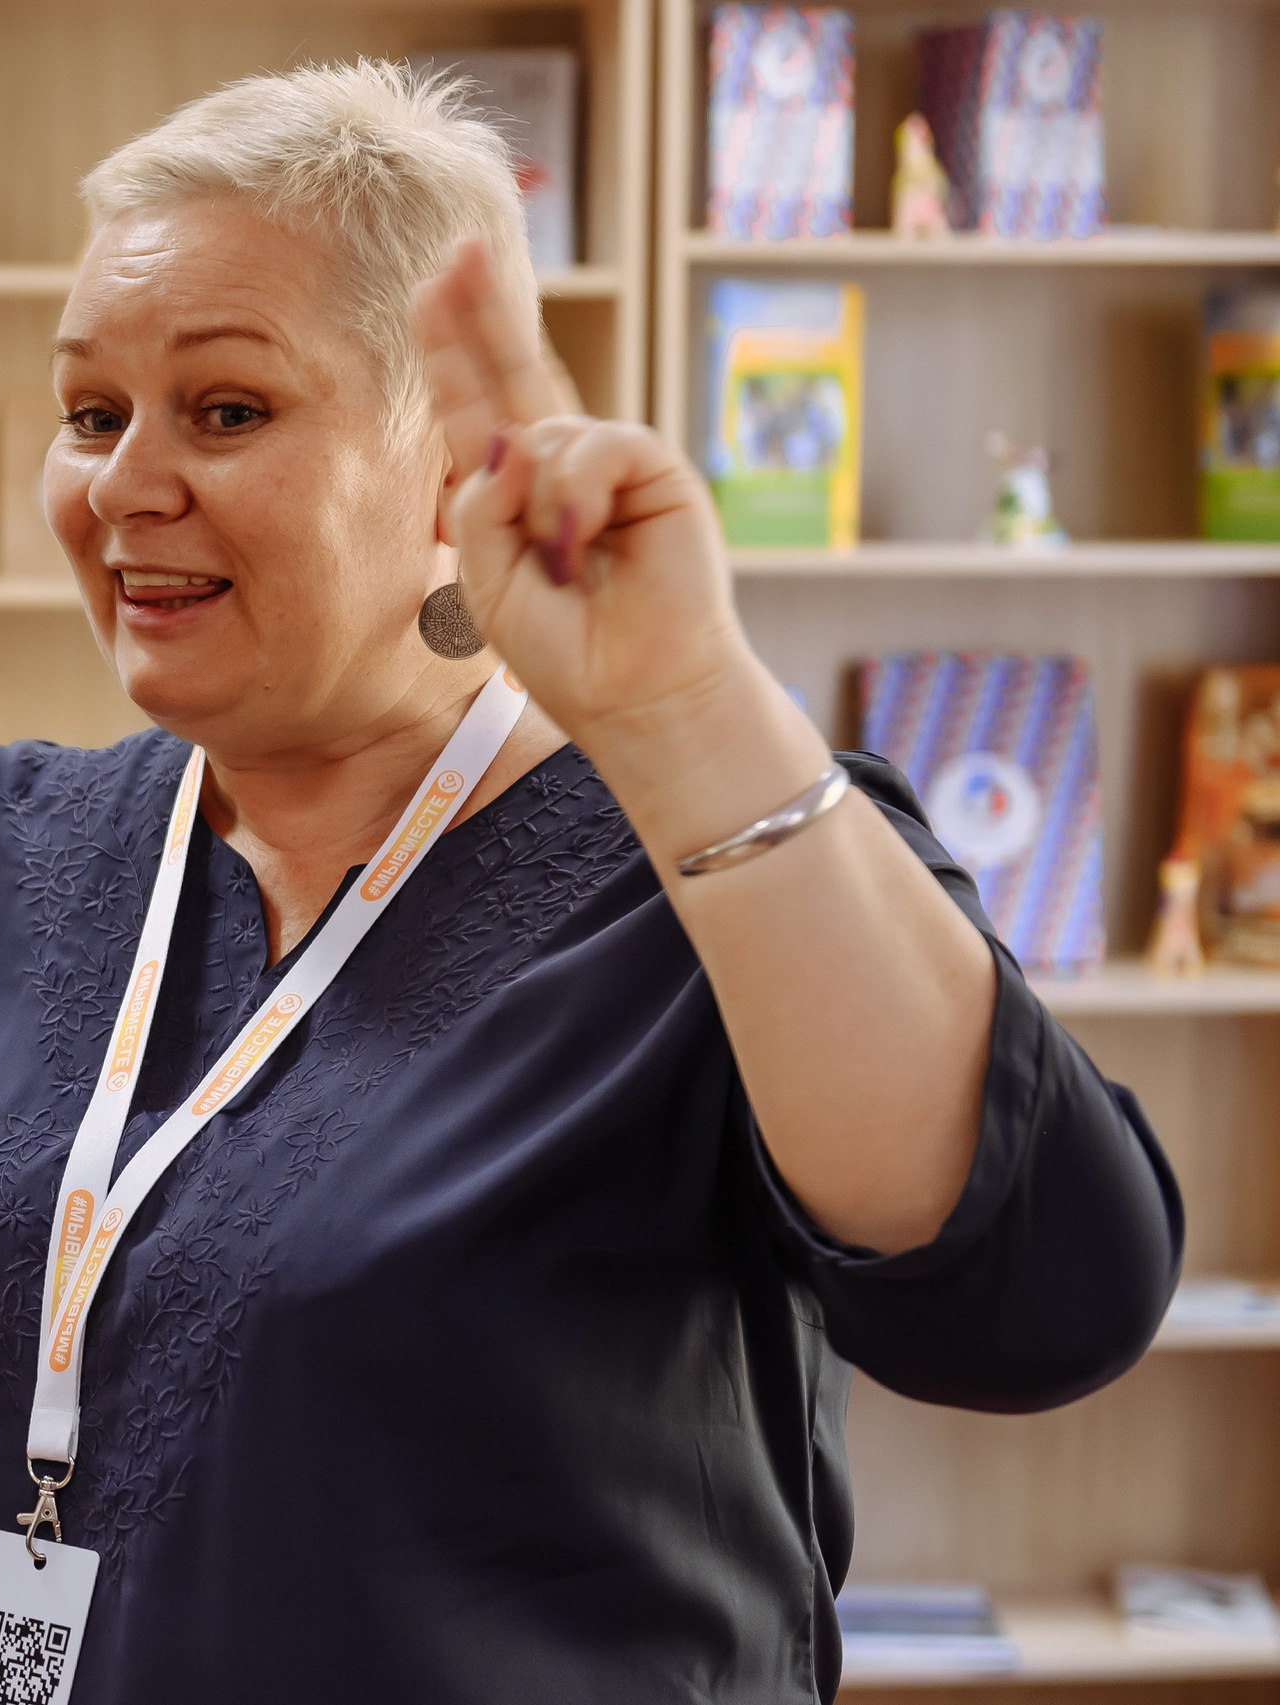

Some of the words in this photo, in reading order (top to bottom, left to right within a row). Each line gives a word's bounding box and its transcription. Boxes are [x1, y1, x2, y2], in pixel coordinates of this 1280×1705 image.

[368, 794, 447, 897] #МЫВМЕСТЕ
[116, 966, 154, 1068] #МЫВМЕСТЕ
[200, 1016, 284, 1111] #МЫВМЕСТЕ
[54, 1236, 110, 1365] #МЫВМЕСТЕ
